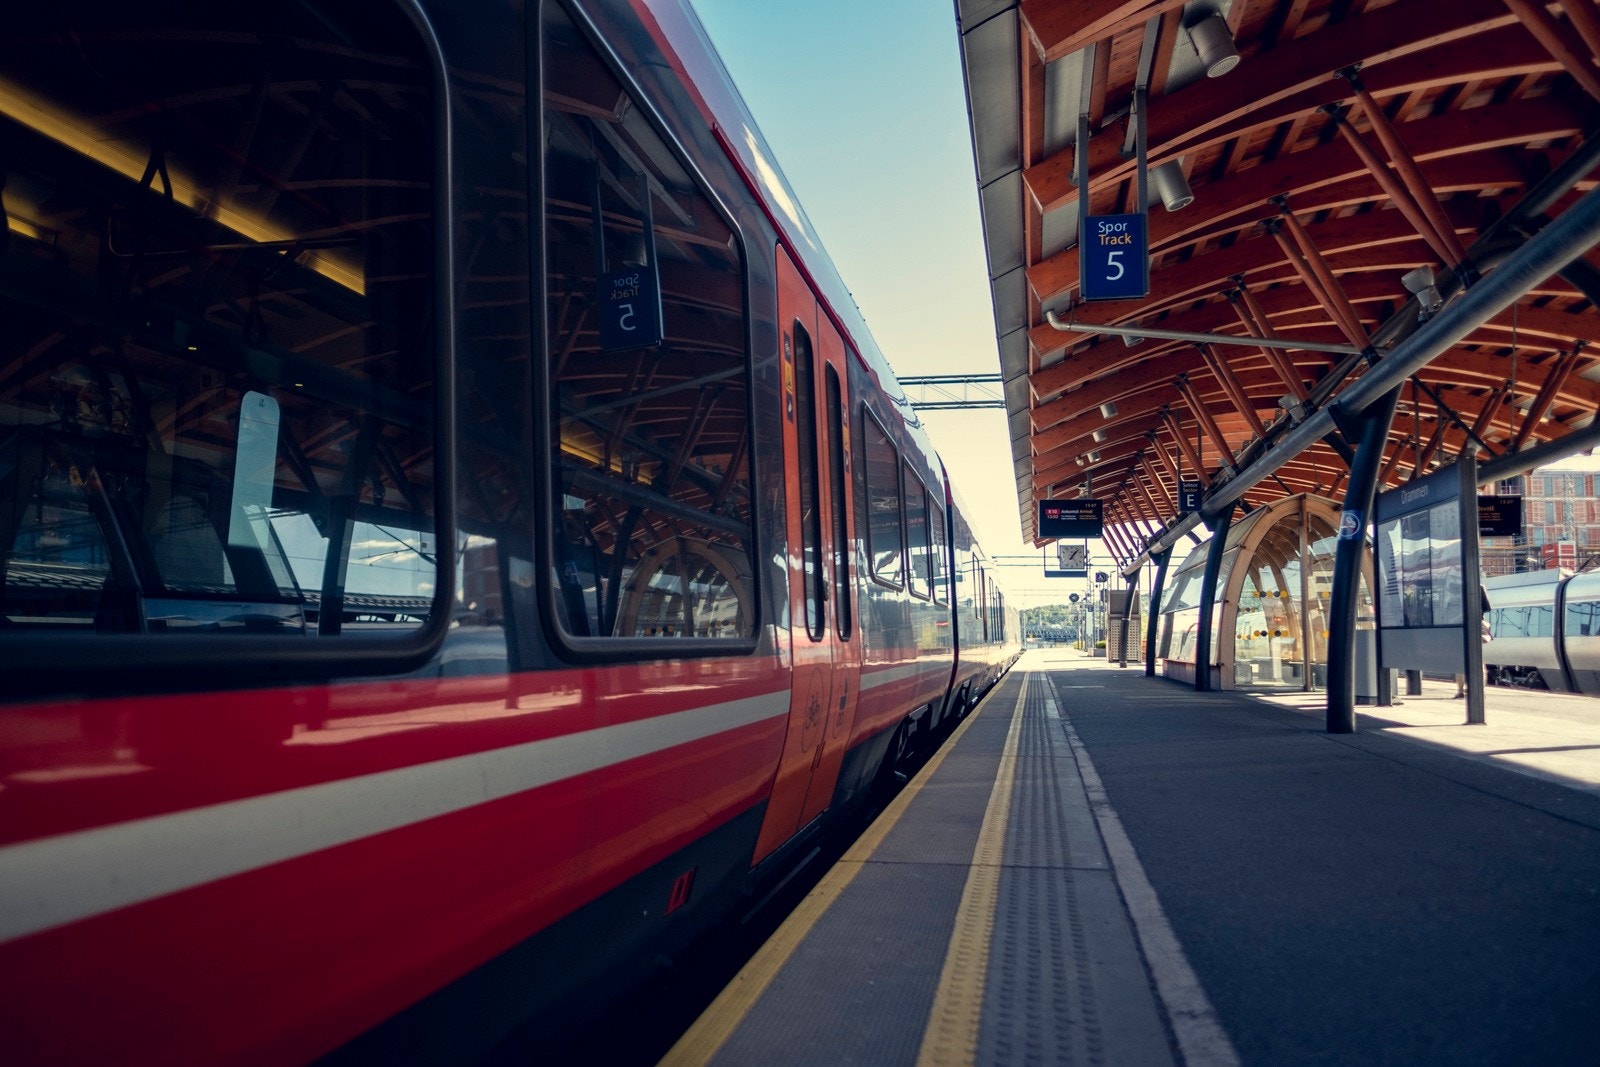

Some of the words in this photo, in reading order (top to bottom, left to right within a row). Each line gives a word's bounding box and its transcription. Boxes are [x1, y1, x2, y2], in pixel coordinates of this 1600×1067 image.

[1098, 221, 1128, 235] Spor
[1098, 233, 1132, 246] Track
[1106, 251, 1125, 281] 5
[1187, 494, 1195, 506] E
[1401, 485, 1428, 504] Drammen
